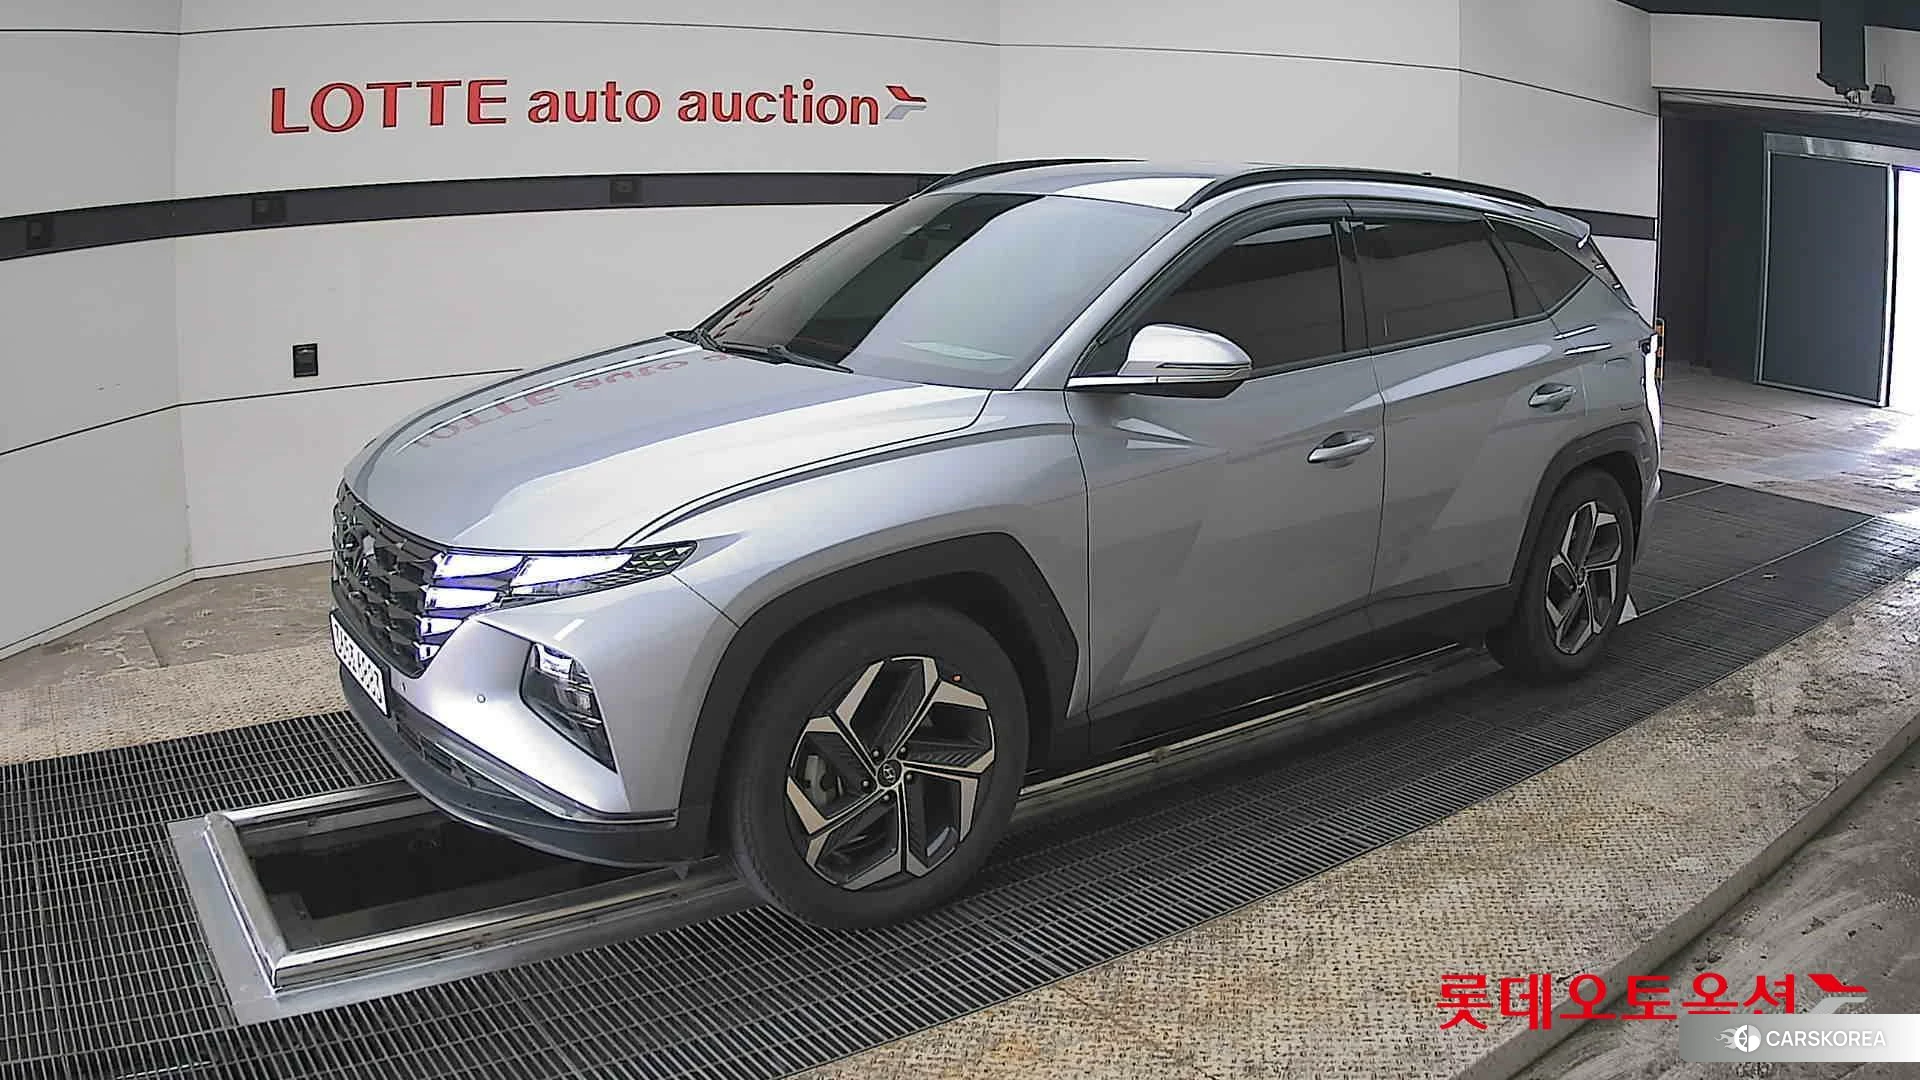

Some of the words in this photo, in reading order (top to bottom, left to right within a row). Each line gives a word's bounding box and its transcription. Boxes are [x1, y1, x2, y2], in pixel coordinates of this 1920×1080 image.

[271, 79, 508, 134] LOTTE
[527, 80, 661, 124] auto
[677, 78, 880, 125] auction
